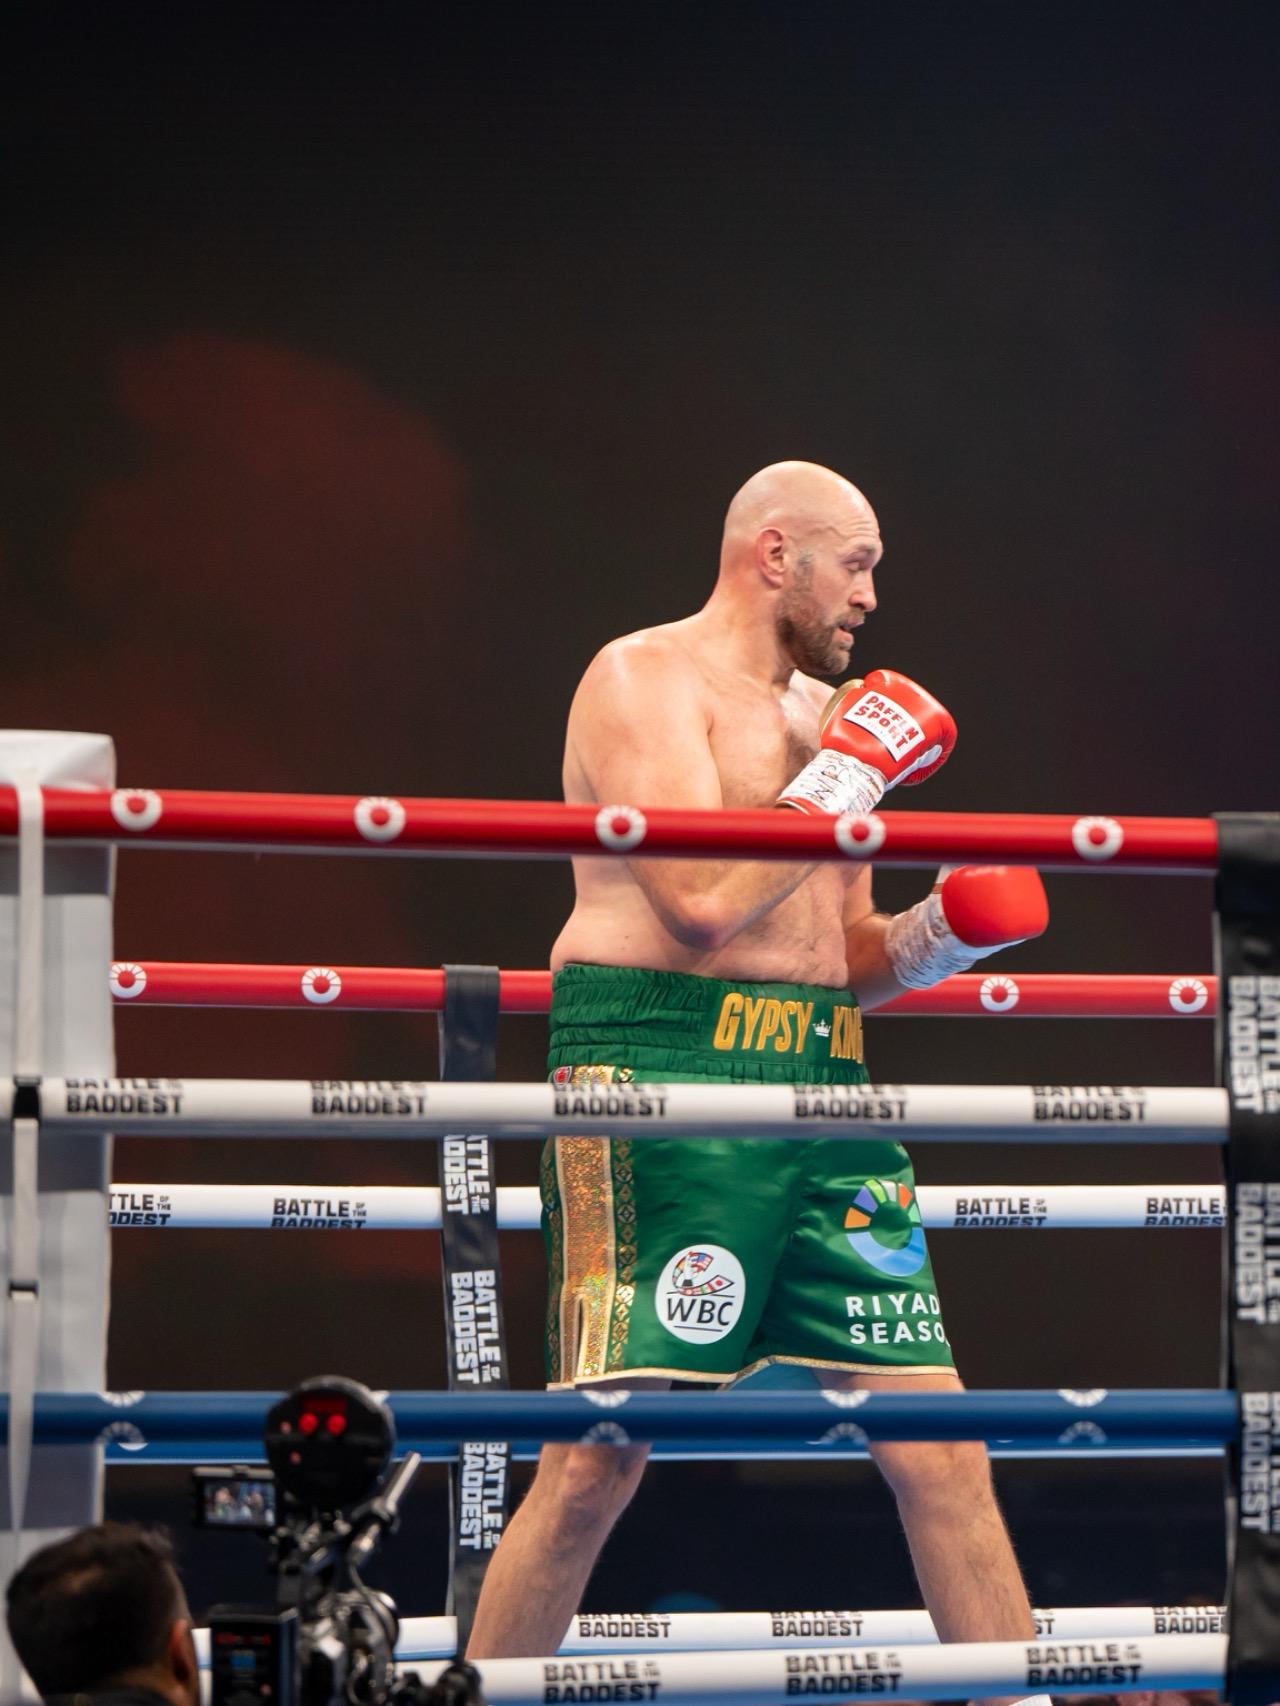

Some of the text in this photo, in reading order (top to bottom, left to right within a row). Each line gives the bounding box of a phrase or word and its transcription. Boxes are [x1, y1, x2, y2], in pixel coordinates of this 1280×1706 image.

[713, 992, 814, 1054] GYPSY
[1229, 976, 1264, 1114] BADDEST
[67, 1094, 183, 1113] BADDEST
[312, 1096, 426, 1114] BADDEST
[554, 1098, 668, 1116] BADDEST
[795, 1100, 908, 1118] BADDEST
[1034, 1102, 1145, 1120] BADDEST
[444, 1135, 469, 1215] DDEST
[467, 1135, 490, 1194] TTLE
[274, 1199, 349, 1217] BATTLE
[956, 1198, 1030, 1215] BATTLE
[1146, 1197, 1220, 1214] BATTLE
[1144, 1216, 1226, 1226] BADDES
[1236, 1182, 1266, 1324] BADDEST
[474, 1270, 501, 1362] BATTLE
[667, 1298, 734, 1326] WBC
[845, 1293, 940, 1317] RIYAD
[451, 1271, 479, 1384] BADDEST
[850, 1322, 950, 1347] SEASO
[1241, 1391, 1270, 1534] BADDEST
[459, 1442, 485, 1549] BADDEST
[483, 1442, 507, 1528] BATTLE
[579, 1622, 672, 1638] BADDEST
[772, 1620, 864, 1637] BADDEST
[786, 1653, 879, 1673] BATTLE
[1026, 1644, 1120, 1664] BATTLE
[544, 1661, 638, 1682] BATTLE
[1026, 1665, 1142, 1687] BADDEST
[544, 1682, 660, 1704] BADDEST
[785, 1674, 902, 1696] BADDEST
